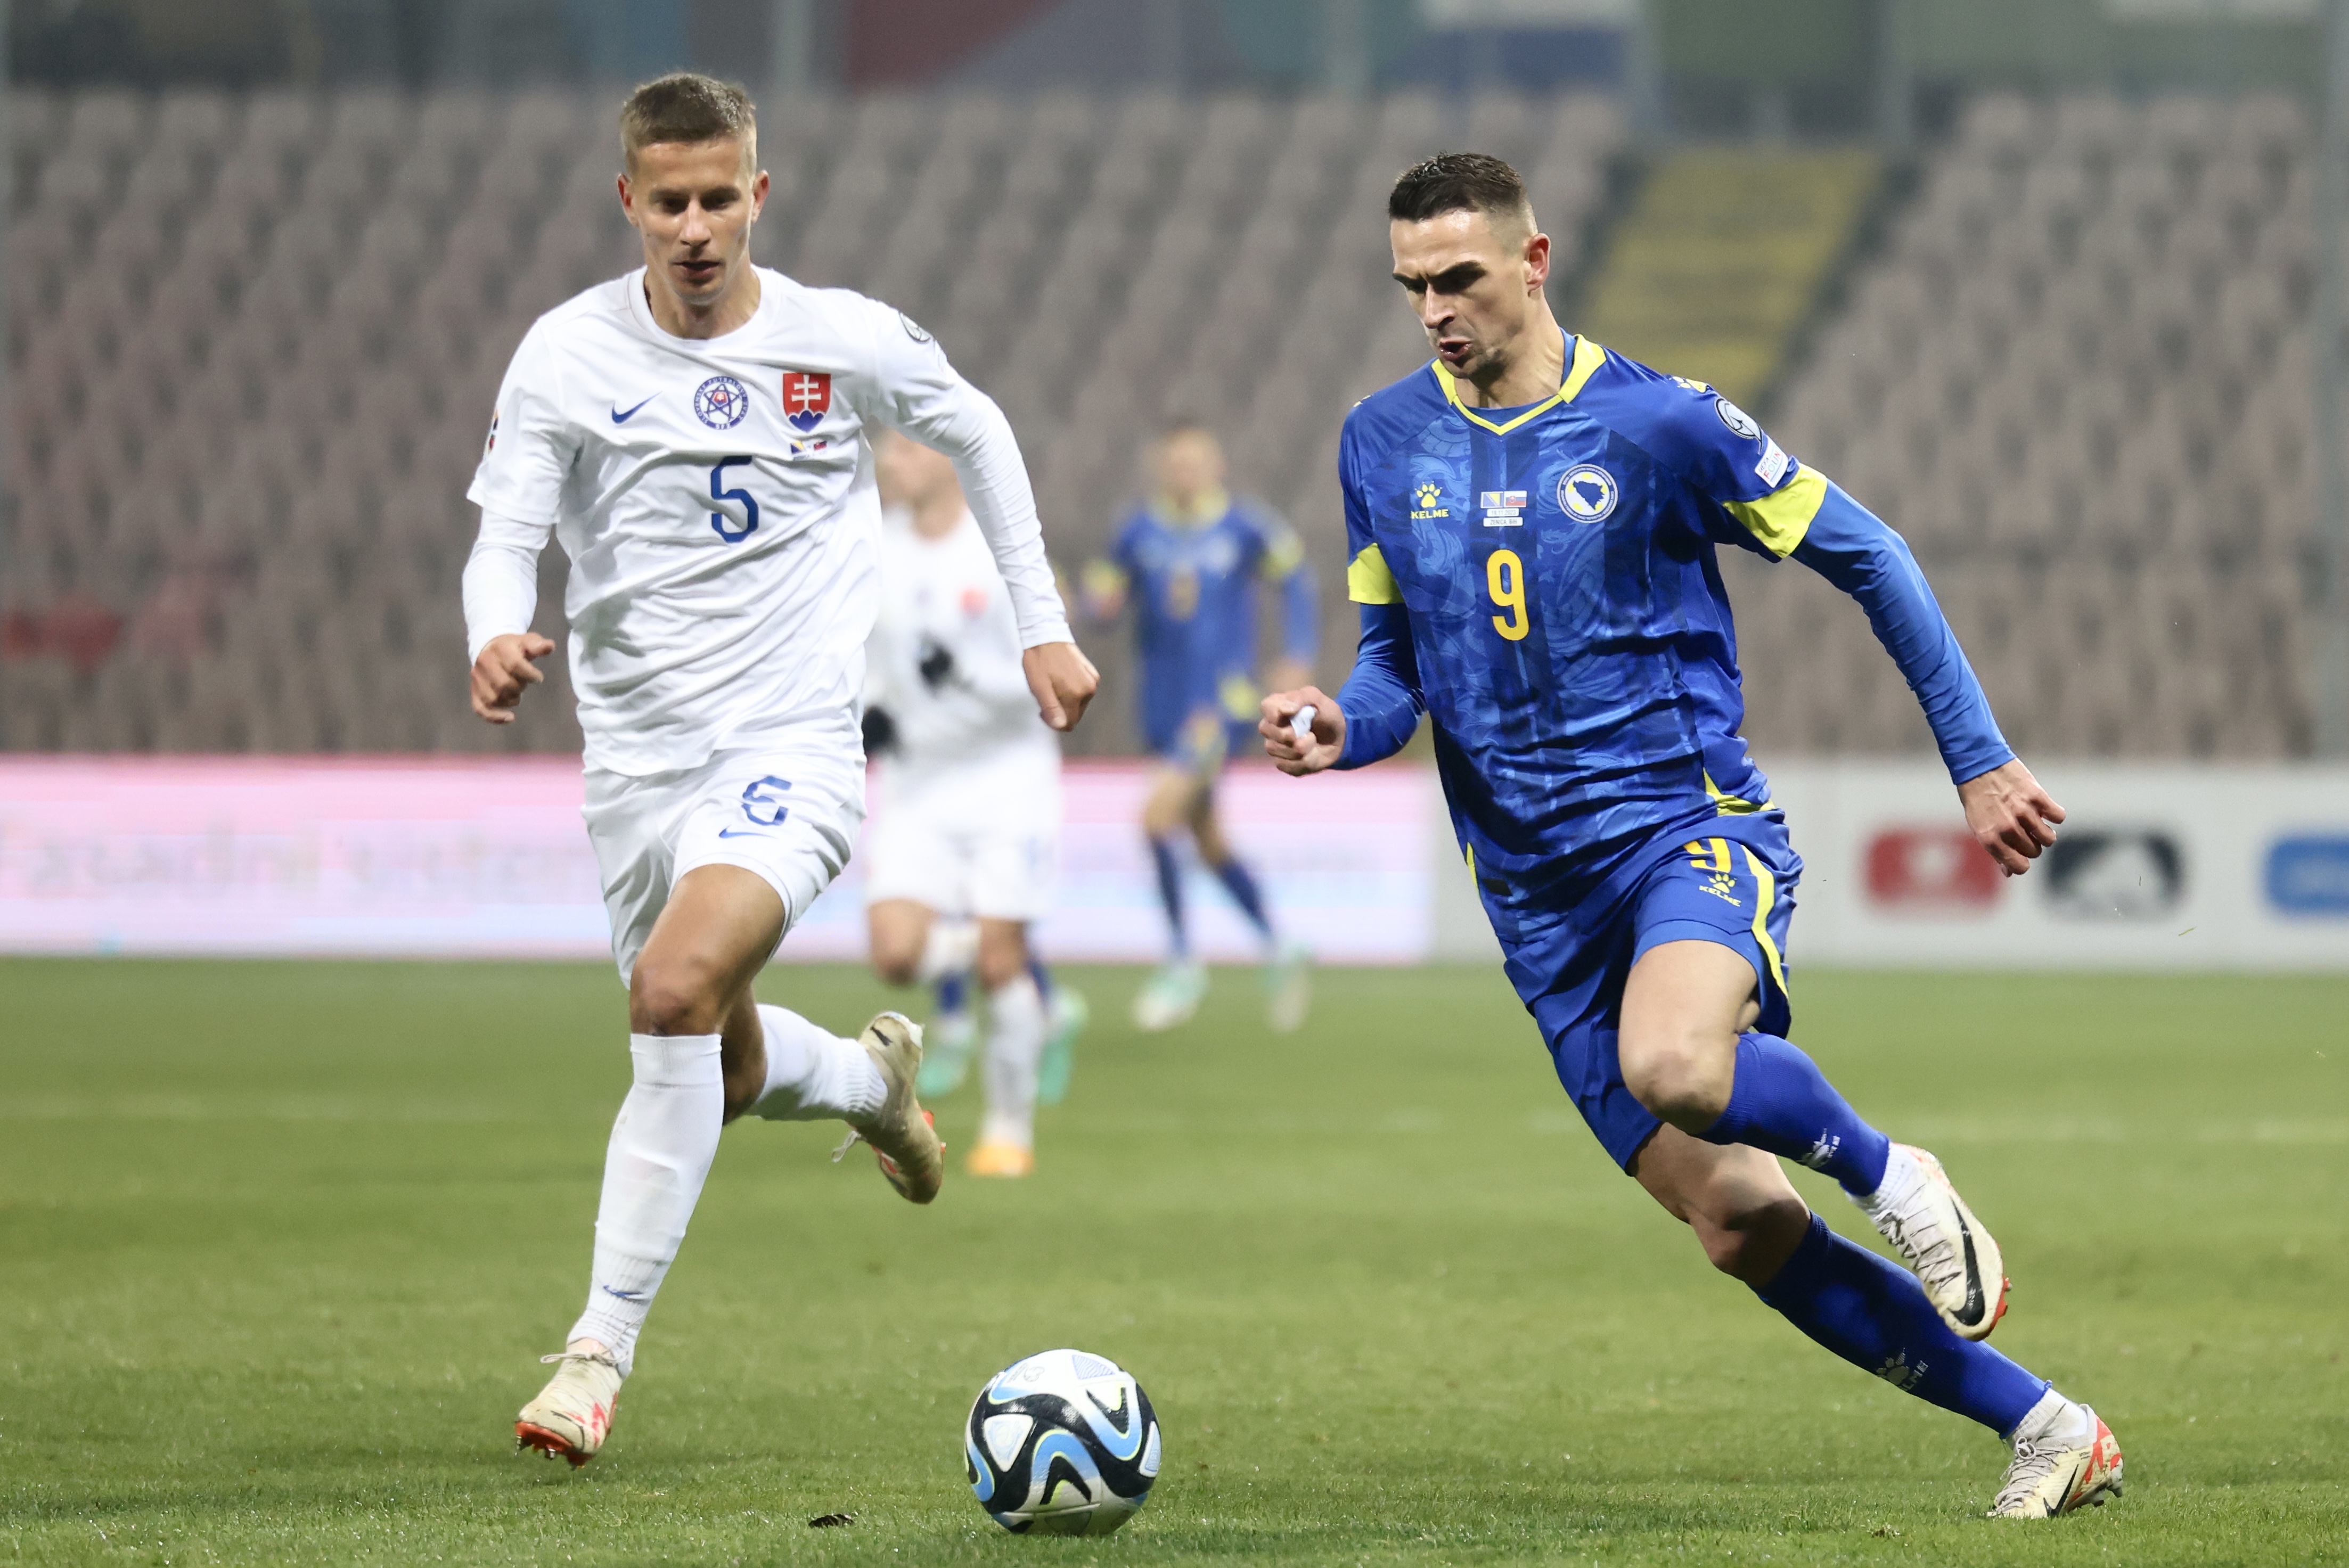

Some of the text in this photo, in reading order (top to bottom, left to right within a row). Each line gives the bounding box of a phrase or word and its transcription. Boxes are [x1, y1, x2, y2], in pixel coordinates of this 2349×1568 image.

[1758, 457, 1770, 473] UEFA
[711, 455, 759, 544] 5
[1411, 508, 1449, 519] KELME
[1486, 548, 1530, 641] 9
[1683, 837, 1732, 874] 9
[1698, 884, 1742, 907] KELME
